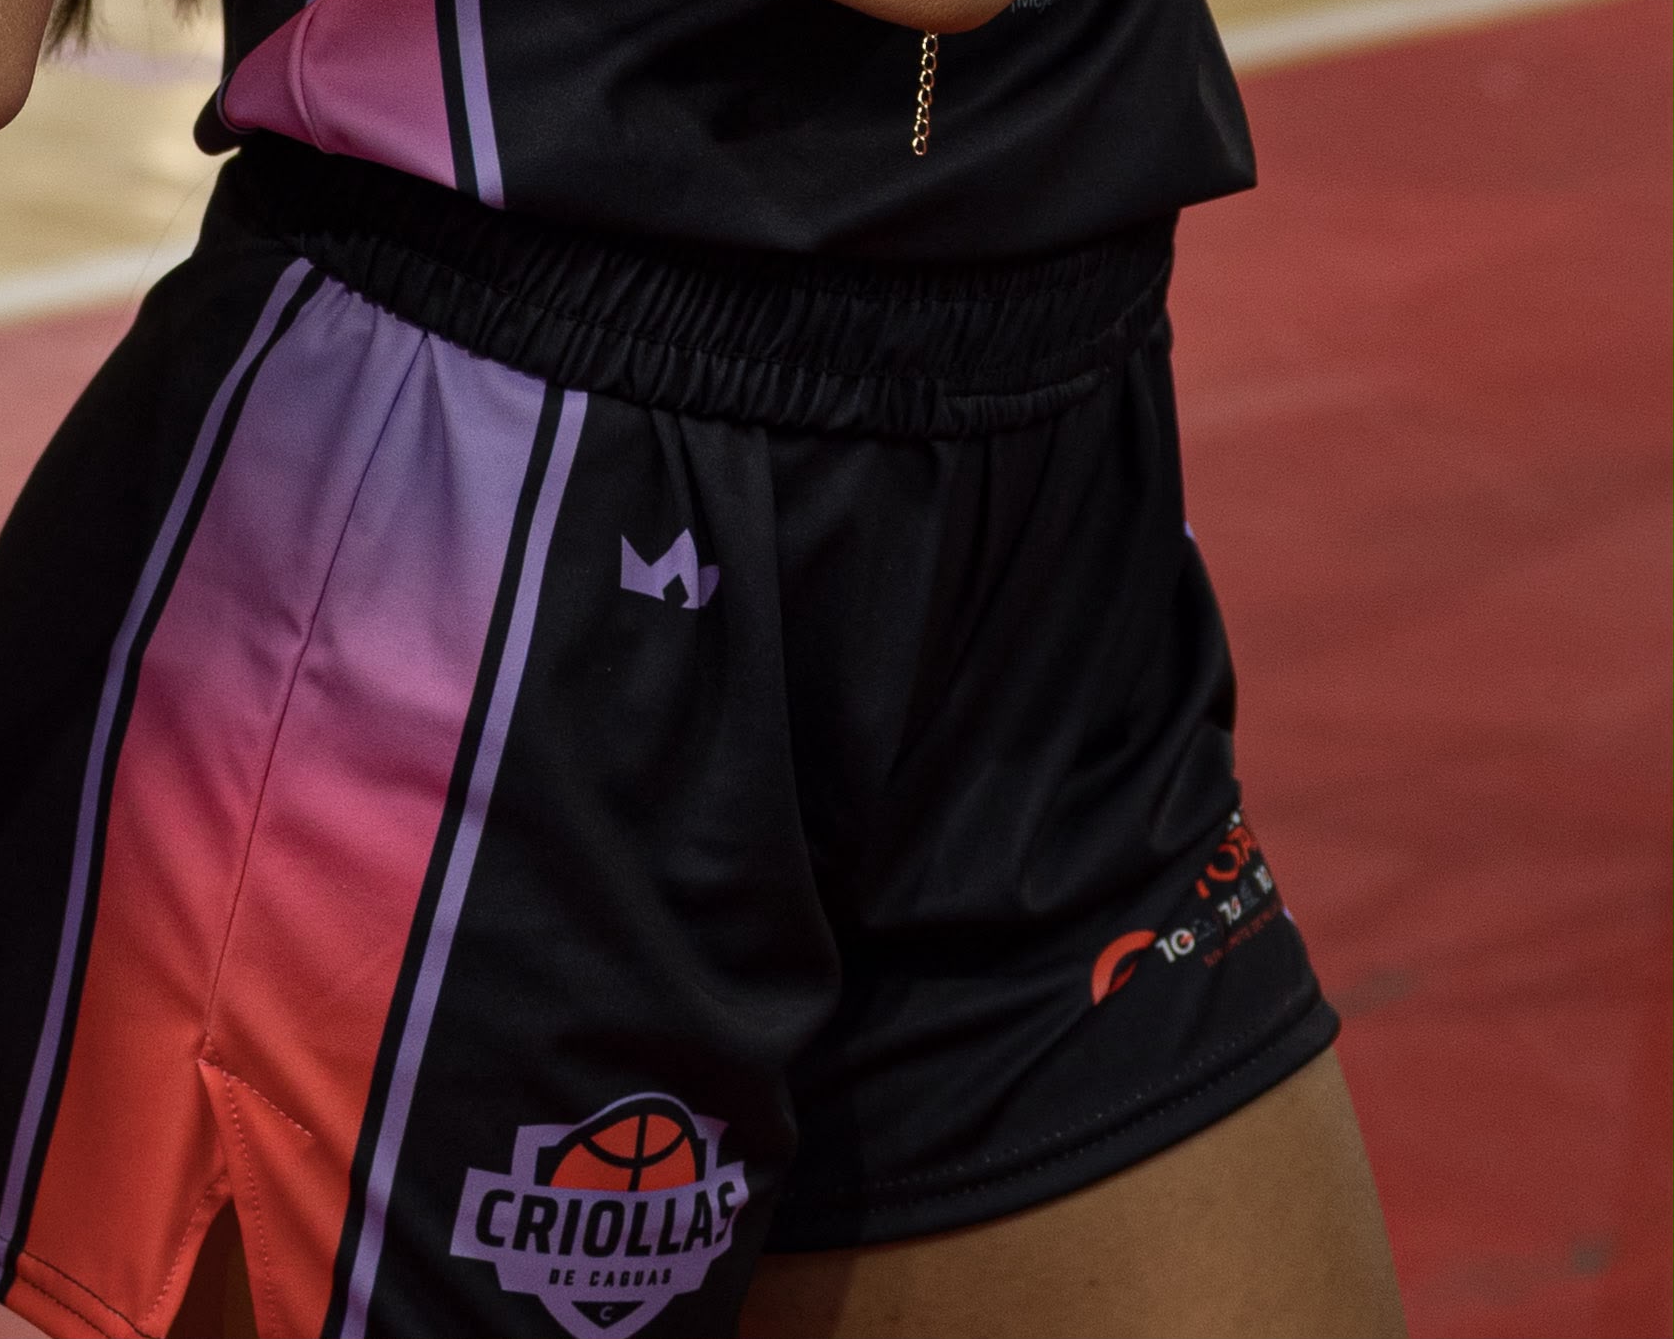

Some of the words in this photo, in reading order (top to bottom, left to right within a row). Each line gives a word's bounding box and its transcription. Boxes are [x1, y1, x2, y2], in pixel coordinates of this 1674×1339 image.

[475, 1180, 737, 1258] CRIOLLAS
[548, 1268, 575, 1286] DE
[588, 1268, 672, 1288] CAGUAS
